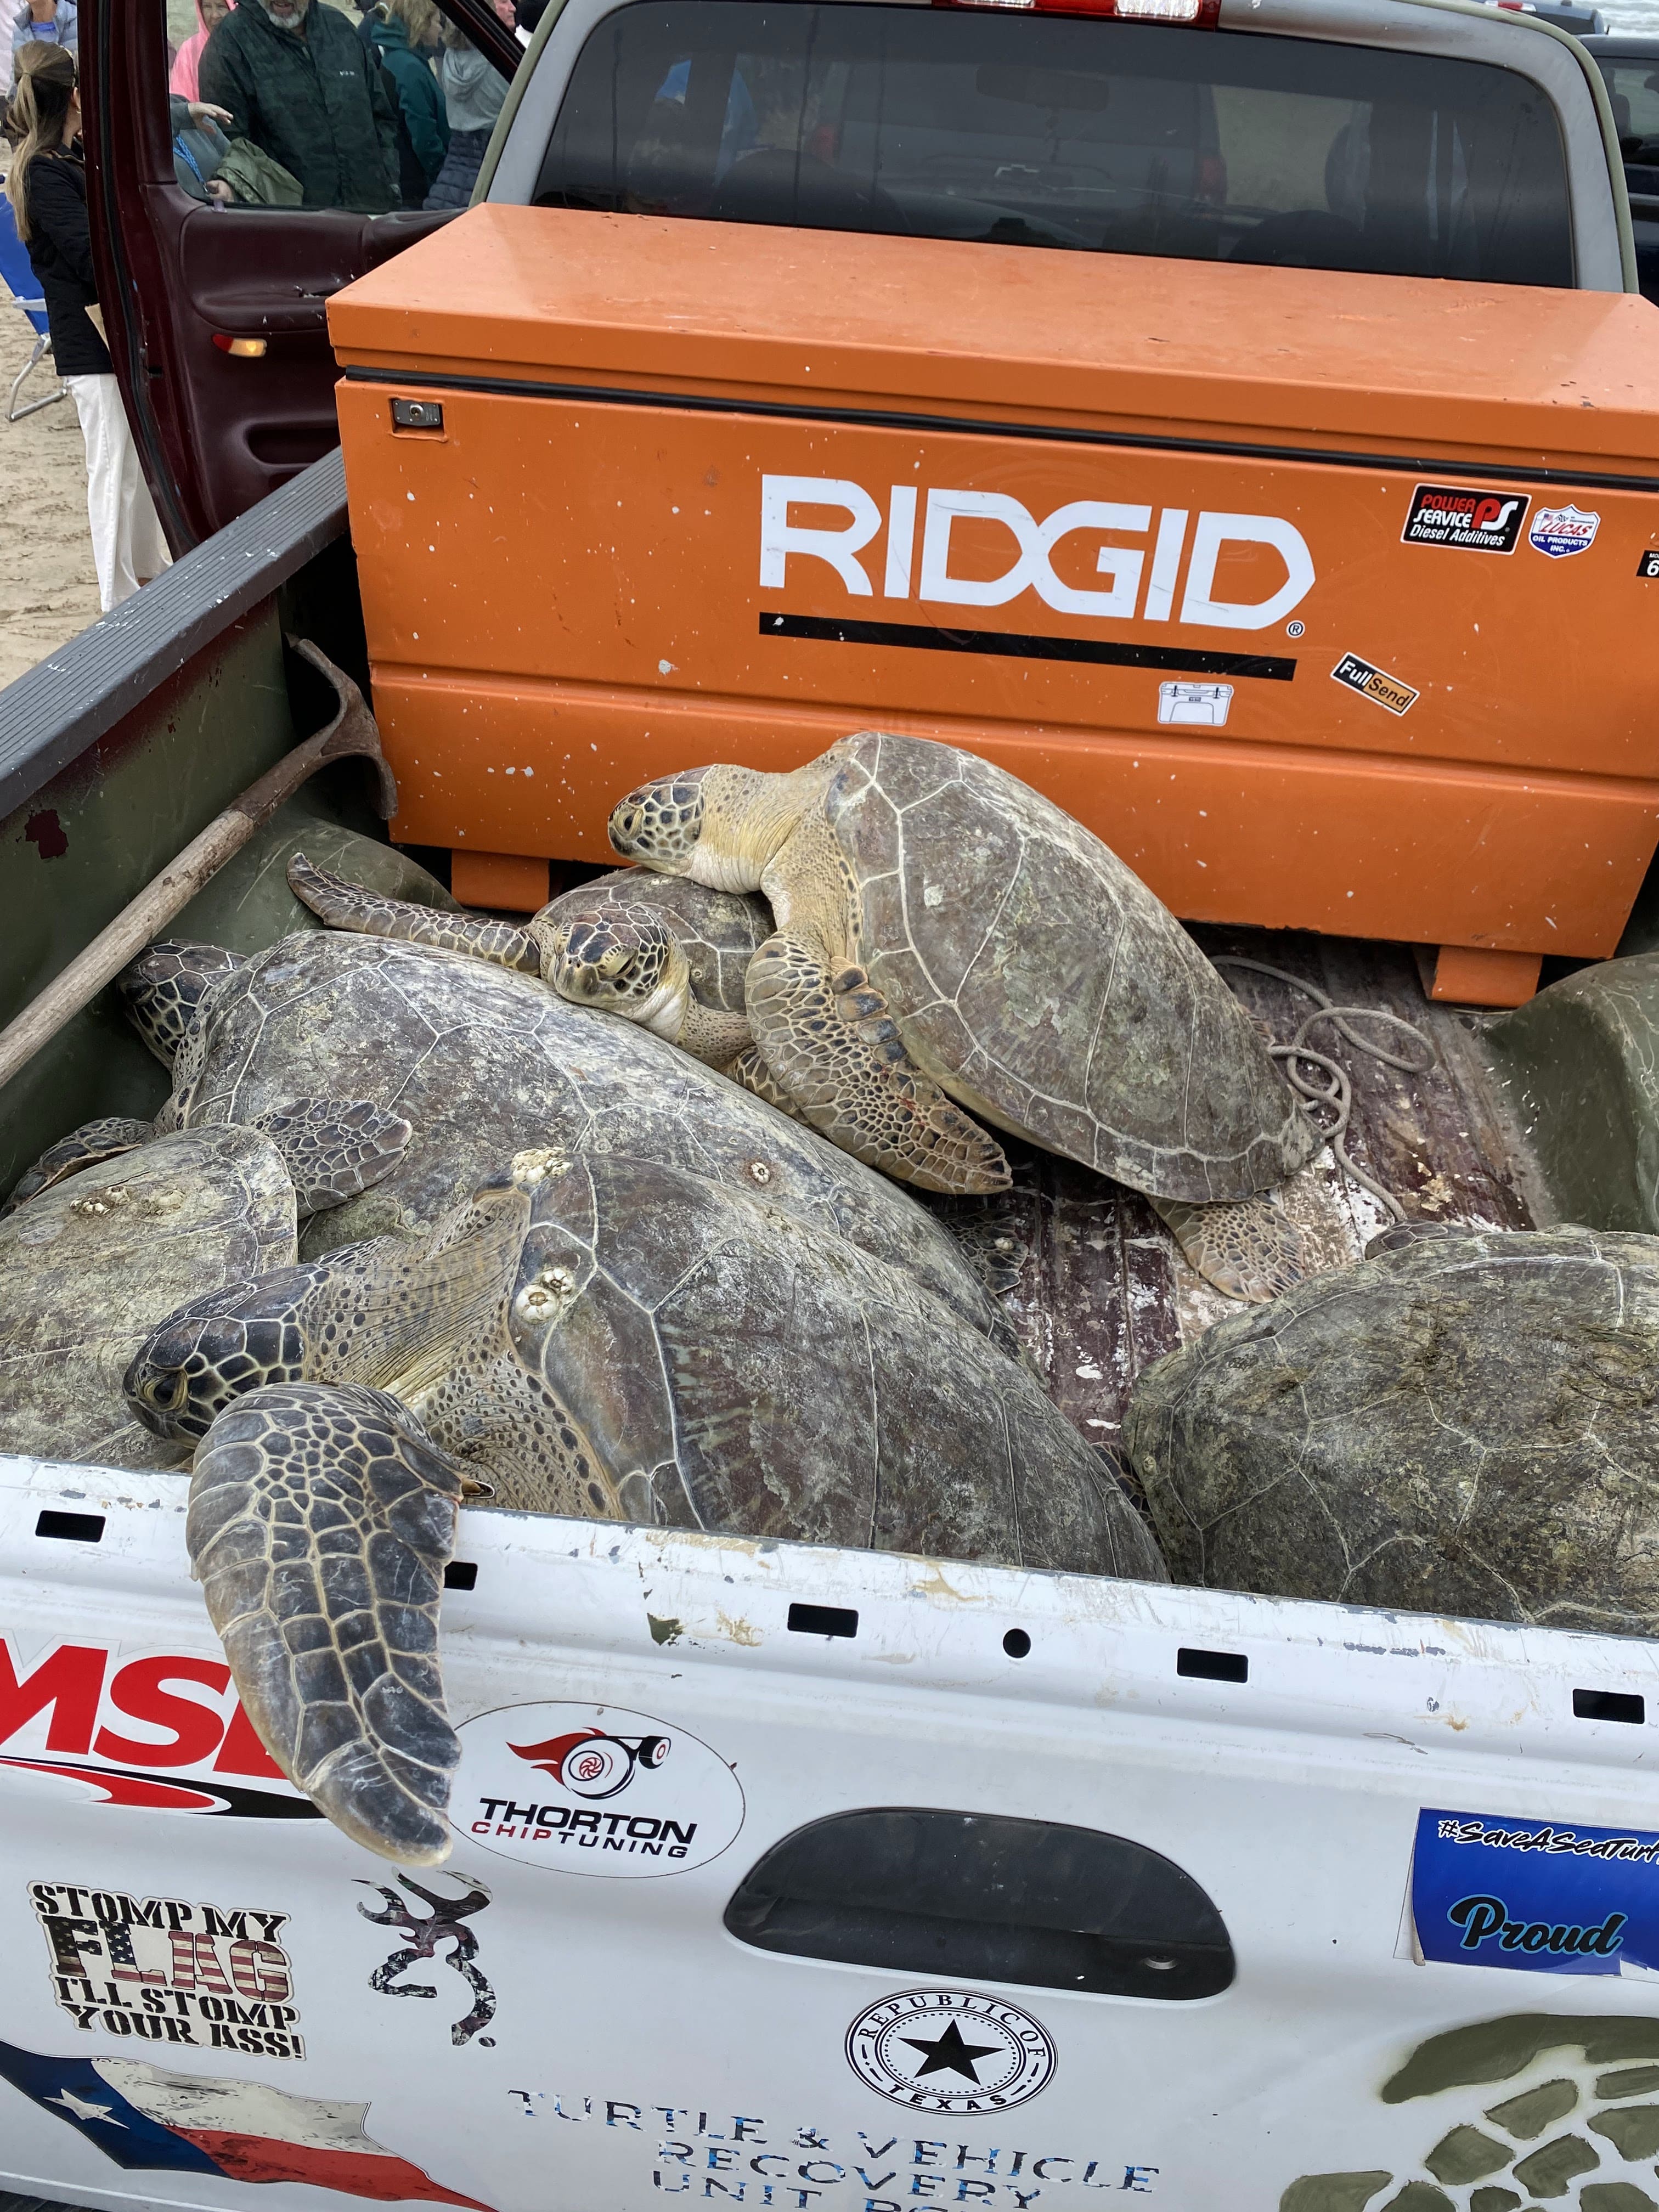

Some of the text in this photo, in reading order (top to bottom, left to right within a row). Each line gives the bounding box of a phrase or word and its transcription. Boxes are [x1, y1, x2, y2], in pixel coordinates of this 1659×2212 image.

[1413, 508, 1472, 528] SERVICE
[1420, 494, 1476, 512] POWER
[760, 474, 1315, 630] RIDGID
[1409, 523, 1505, 546] Diesel Additives
[1538, 522, 1593, 536] LUCAS
[1547, 537, 1588, 546] PRODUCTS
[1339, 660, 1410, 707] Full Send
[0, 1638, 291, 1781] MS
[471, 1821, 689, 1859] CHIPTUNING
[479, 1797, 697, 1844] THORTON
[1438, 1820, 1659, 1865] #SaveASeaTurt
[32, 1884, 286, 1943] STOMP MY
[1447, 1894, 1628, 1958] Proud
[42, 1915, 289, 2003] FLAG
[55, 1977, 296, 2030] I'LL STOMP
[858, 1994, 1046, 2058] REPUBLIC OF
[61, 2002, 302, 2059] YOUR ASS!
[888, 2084, 1007, 2111] TEXAS
[507, 2089, 1160, 2193] TURTLE & VEHICLE
[653, 2170, 822, 2210] UNIT
[657, 2140, 1041, 2210] RECOVERY
